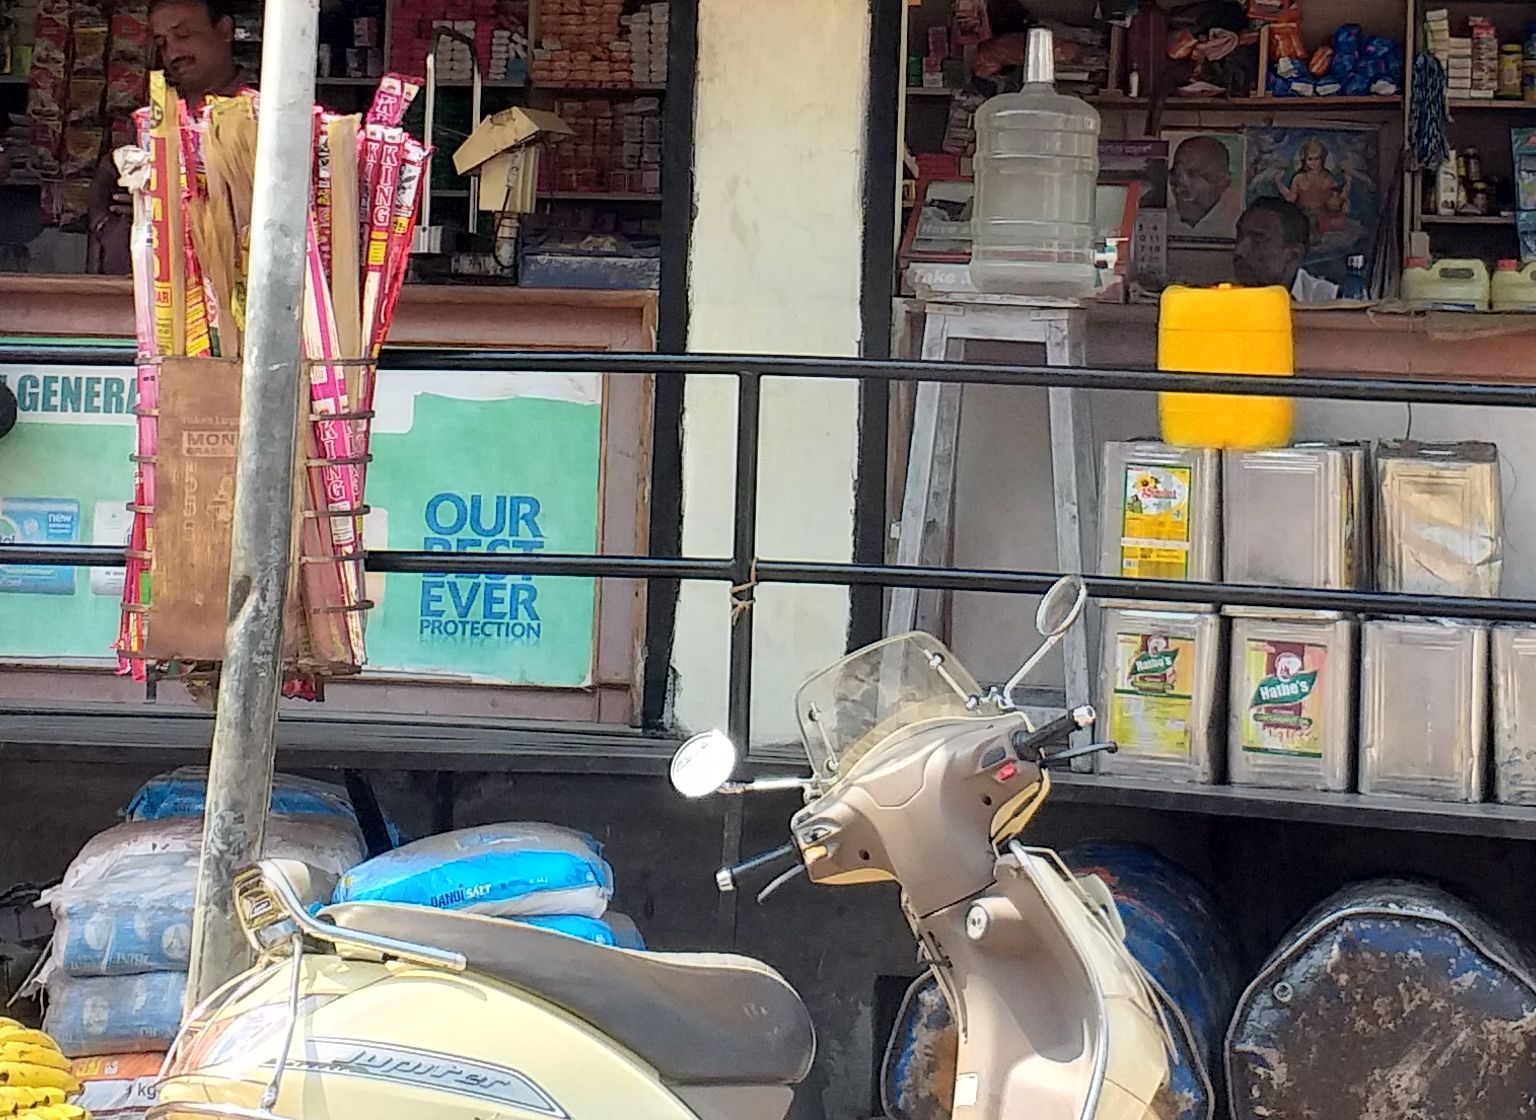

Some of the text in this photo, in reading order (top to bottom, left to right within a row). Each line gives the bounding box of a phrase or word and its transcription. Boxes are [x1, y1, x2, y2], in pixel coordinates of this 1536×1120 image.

[372, 141, 400, 228] KING
[424, 492, 545, 538] OUR
[420, 580, 541, 621] EVER
[419, 619, 541, 639] PROTECTION
